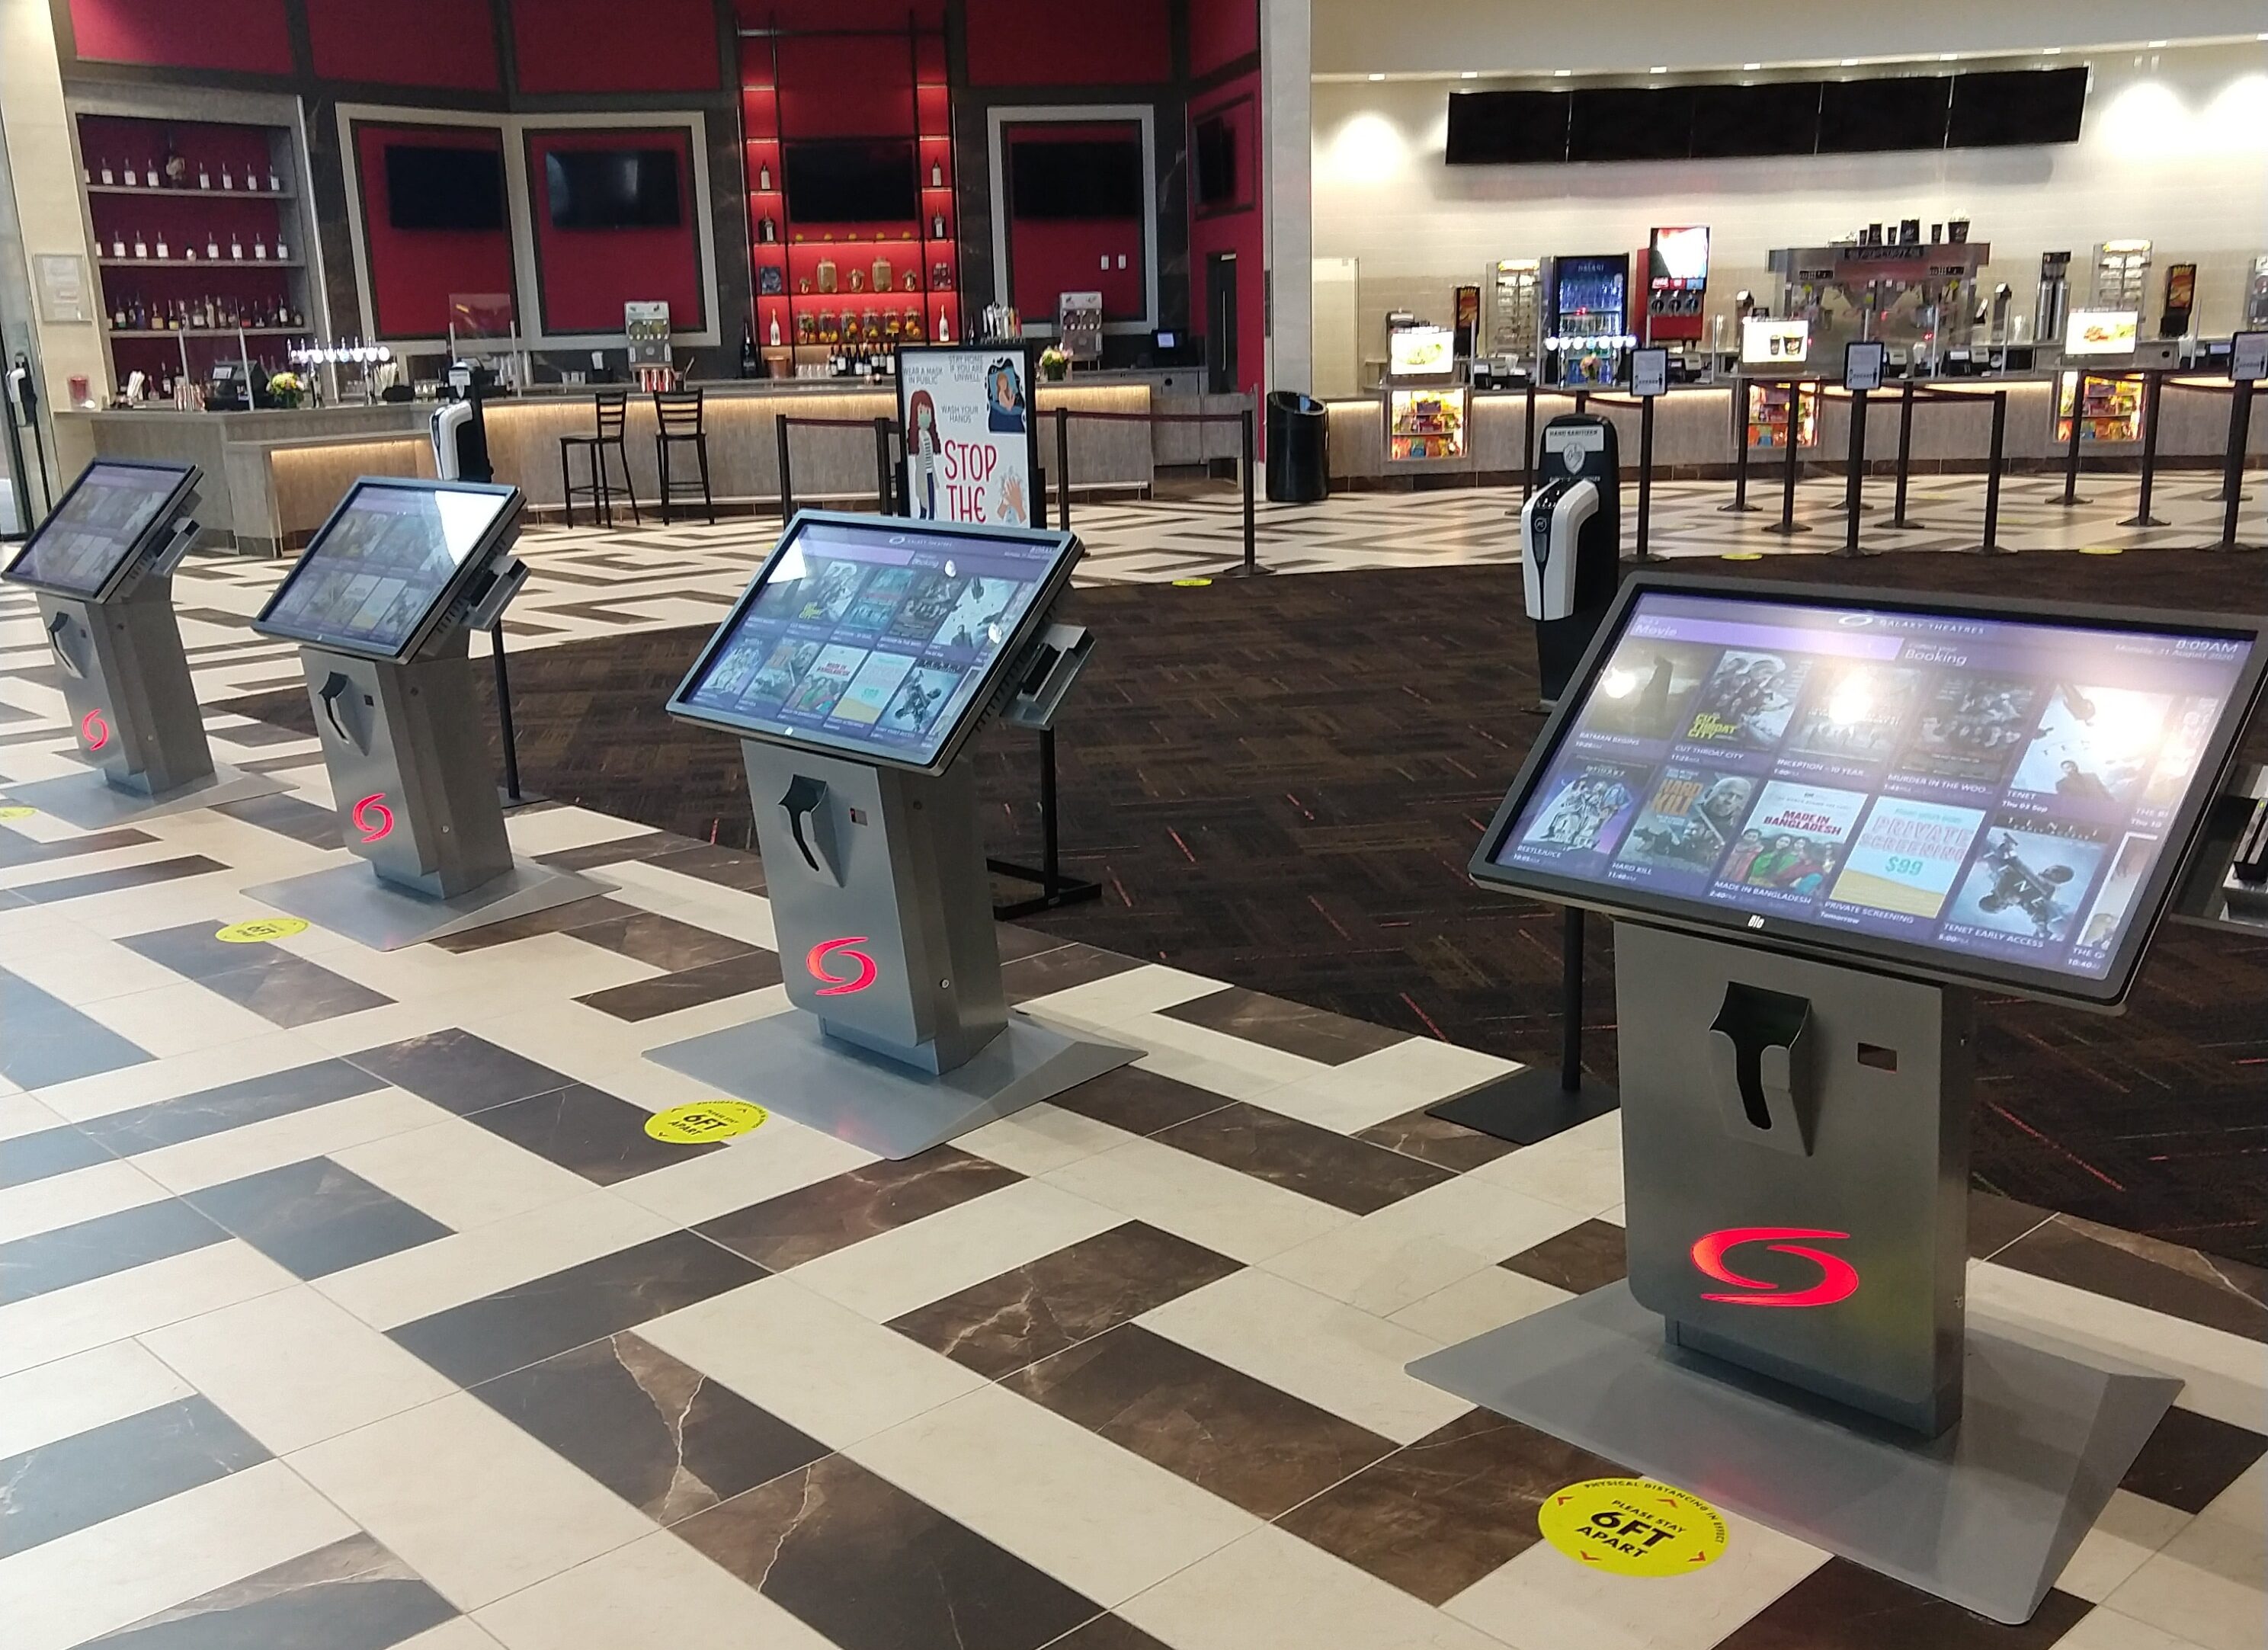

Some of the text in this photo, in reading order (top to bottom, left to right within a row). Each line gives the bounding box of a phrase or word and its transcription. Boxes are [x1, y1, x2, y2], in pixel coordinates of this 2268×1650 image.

[948, 355, 983, 364] STAY HOME
[902, 367, 920, 375] WEAR
[926, 367, 943, 376] MASK
[954, 373, 980, 382] UNWELL
[917, 376, 938, 385] PUBLIC
[961, 405, 979, 414] YOUR
[950, 414, 972, 423] HANDS
[945, 440, 997, 482] STOP
[946, 484, 986, 524] THE
[1635, 624, 1677, 636] Movie
[1879, 619, 1985, 635] GALAXY THEATRES
[1904, 648, 1968, 667] Booking
[2172, 649, 2207, 660] August
[1579, 732, 1640, 746] BATMAN BEGINS
[1692, 746, 1725, 758] THROAT
[1725, 751, 1744, 760] CITY
[1776, 758, 1824, 771] INCEPTION
[1830, 766, 1840, 774] 10
[1840, 767, 1865, 777] YEAR
[1659, 779, 1704, 799] HARD
[1887, 774, 1927, 787] MURDER
[1928, 779, 1940, 788] IN
[1941, 780, 1959, 790] THE
[2007, 790, 2036, 800] TENET
[1651, 793, 1693, 817] KILL
[2001, 800, 2018, 809] Thu
[2031, 804, 2049, 814] Sep
[2135, 807, 2154, 817] THE
[1763, 816, 1843, 835] BANGLADESH
[1782, 810, 1831, 825] MADE IN
[1872, 815, 1975, 845] PRIVATE
[1517, 844, 1562, 859] BEETLEJUICE
[1858, 833, 1969, 863] SCREENING
[1612, 861, 1652, 875] HARD KILL
[1885, 855, 1924, 876] $99
[1714, 880, 1812, 905] MADE IN BANGLADESH
[1820, 912, 1860, 925] Tomorrow
[1824, 902, 1915, 924] PRIVATE SCREENING
[1944, 921, 2045, 949] TENET EARLY ACCESS
[2072, 947, 2092, 957] THE
[668, 1120, 703, 1136] APART
[683, 1114, 728, 1130] 6FT
[1584, 1480, 1725, 1544] PHYSICAL DISTANCING IN EFFECT
[1612, 1500, 1687, 1533] PLEASE STAY
[1590, 1511, 1676, 1547] 6FT
[1574, 1526, 1648, 1558] APART
